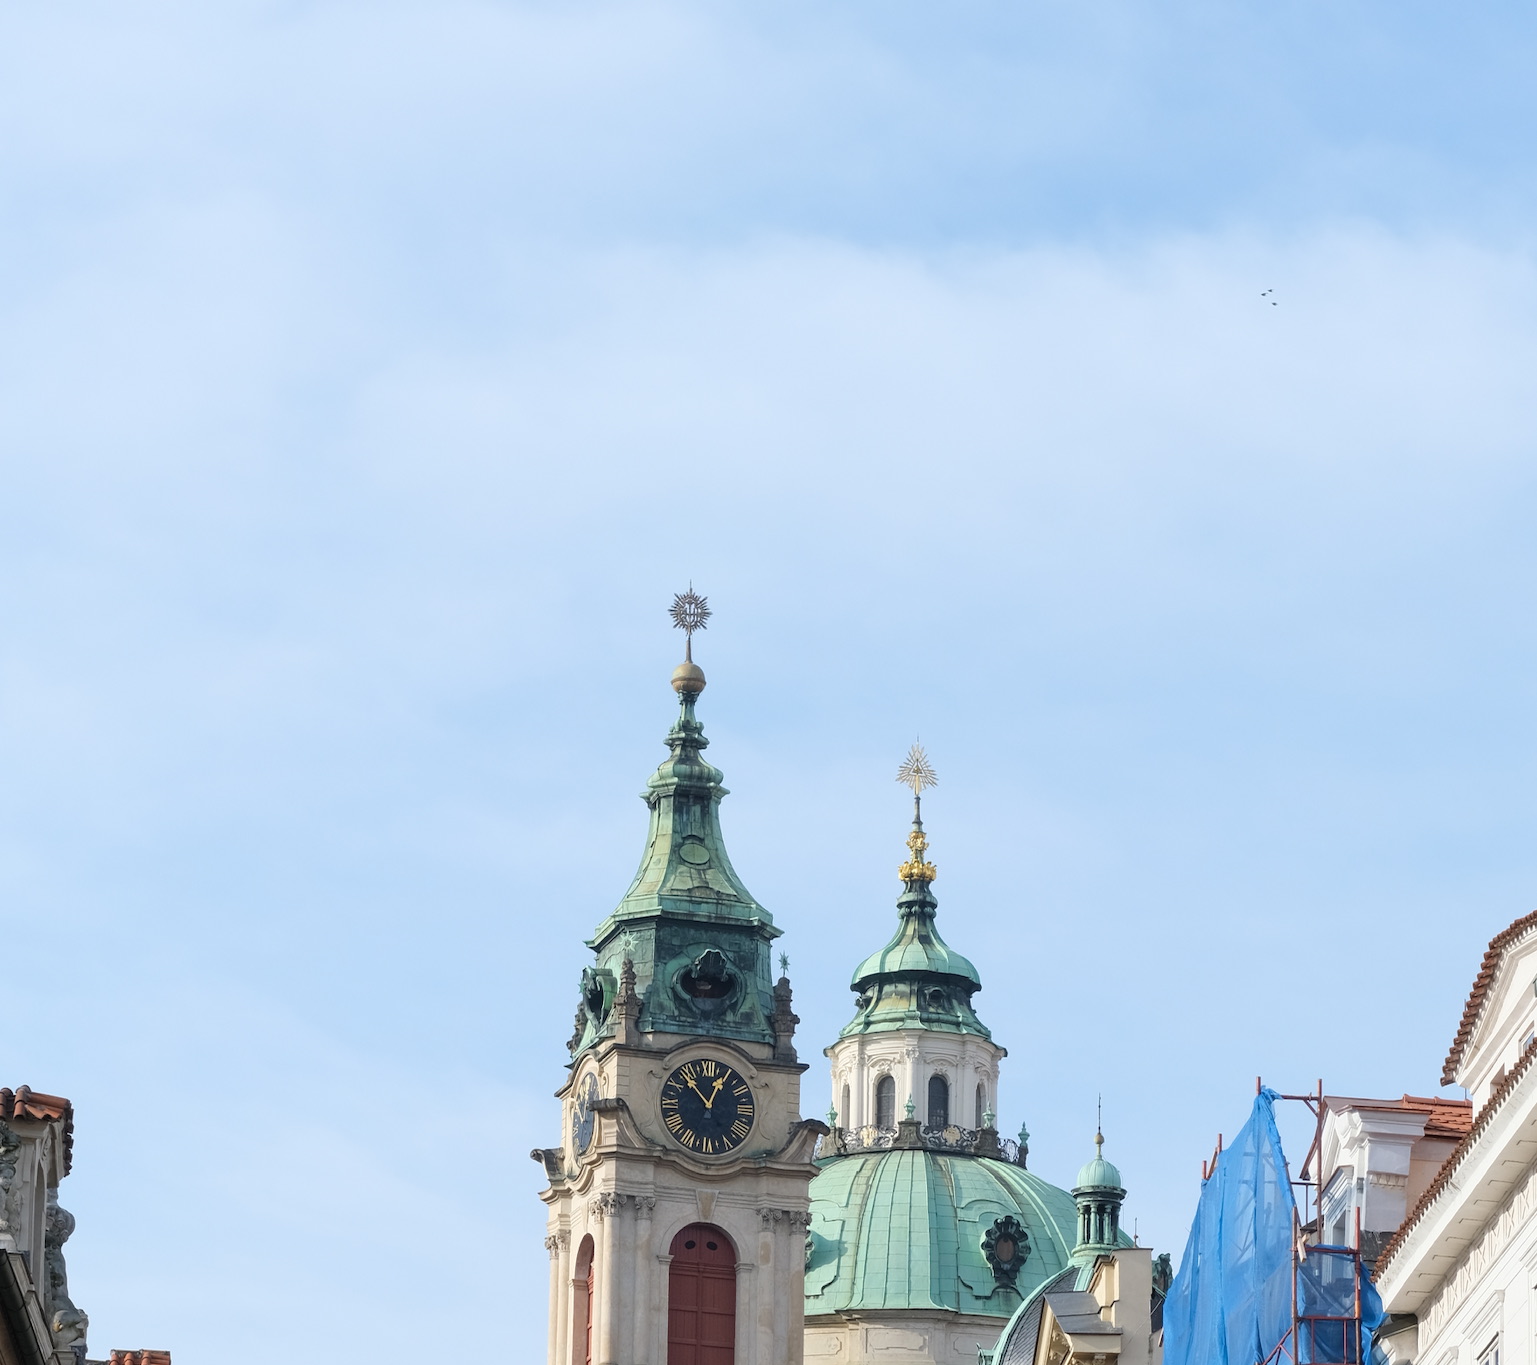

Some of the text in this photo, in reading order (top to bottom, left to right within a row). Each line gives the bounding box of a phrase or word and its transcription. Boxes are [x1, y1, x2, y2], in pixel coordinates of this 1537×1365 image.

[702, 1061, 715, 1078] XII
[667, 1078, 683, 1092] X
[734, 1085, 748, 1096] II
[662, 1096, 679, 1109] IX
[737, 1104, 754, 1116] III
[681, 1129, 695, 1147] VII
[722, 1135, 733, 1150] V
